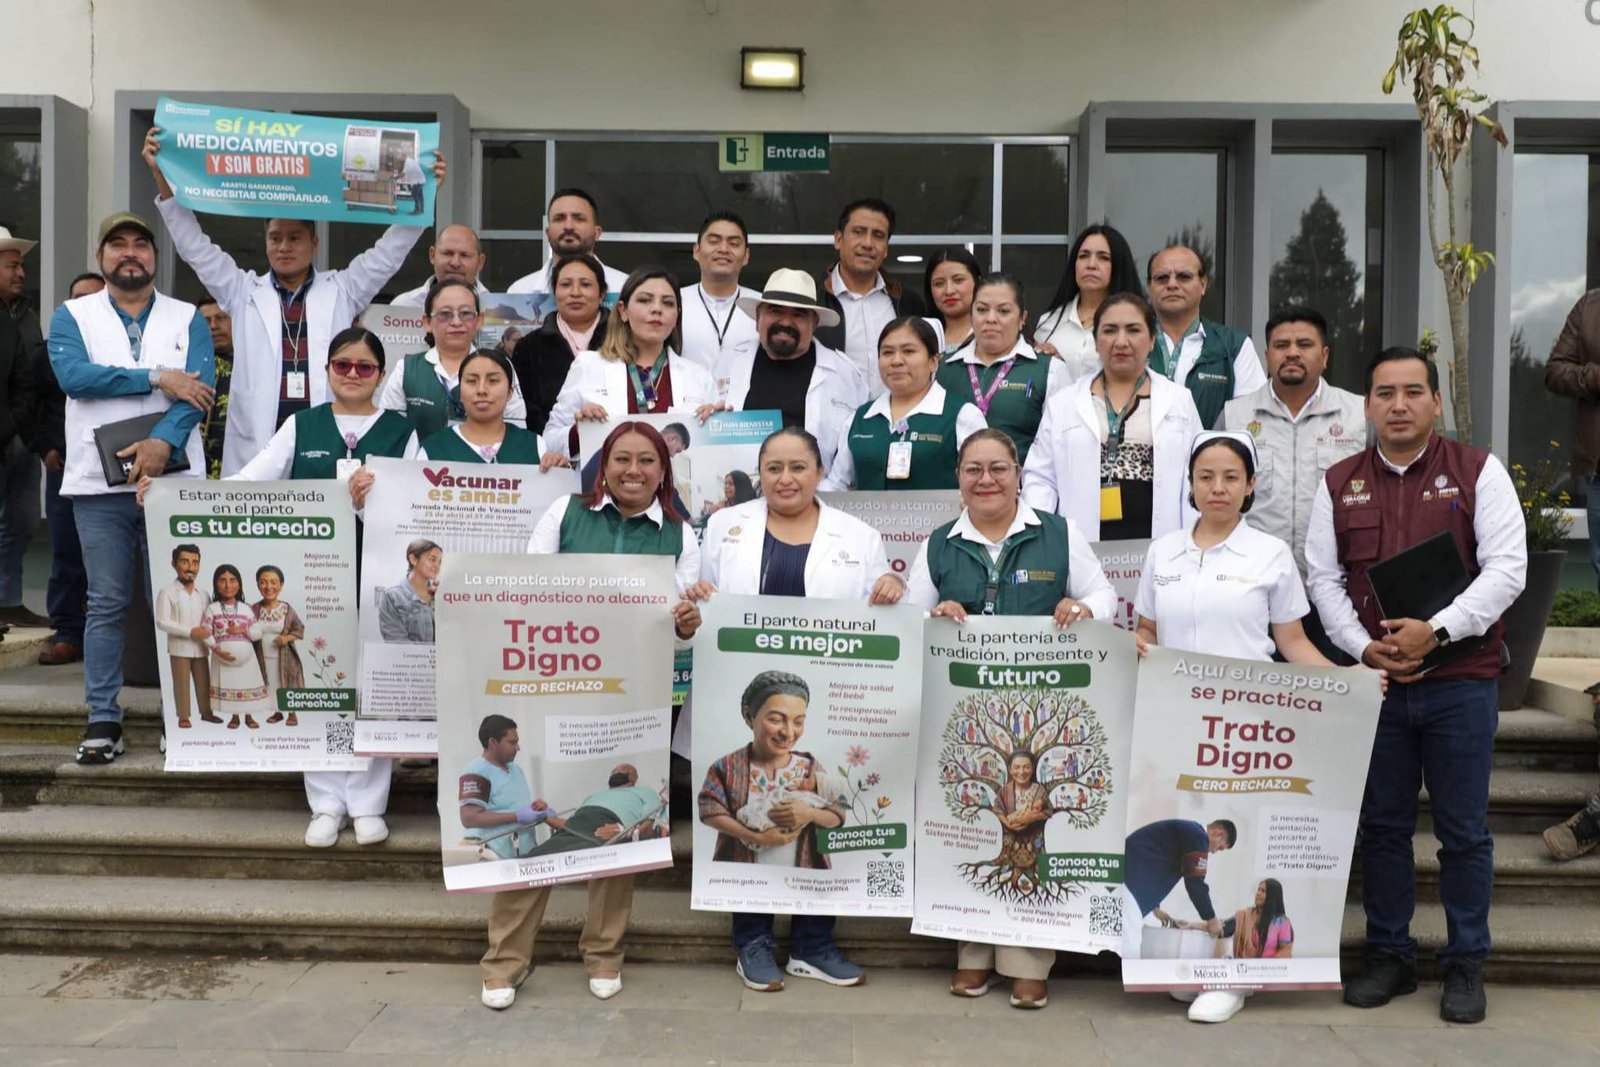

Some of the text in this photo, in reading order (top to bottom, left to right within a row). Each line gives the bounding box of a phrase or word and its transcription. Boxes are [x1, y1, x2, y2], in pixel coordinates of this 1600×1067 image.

[215, 116, 304, 137] SÍ HAY
[176, 133, 338, 158] MEDICAMENTOS
[767, 145, 825, 158] Entrada
[211, 155, 305, 175] Y SON GRATIS
[185, 186, 331, 204] NO NECESITAS COMPRARLOS.
[383, 315, 424, 329] Somo
[422, 467, 522, 490] Vacunar
[179, 489, 325, 504] Estar acompañada
[427, 489, 522, 505] es amar
[212, 503, 295, 517] en el parto
[411, 503, 441, 511] Jornada
[489, 506, 531, 514] Vacunación
[849, 500, 887, 511] todos
[891, 501, 951, 512] estamos
[176, 518, 332, 537] es tu derecho
[874, 515, 897, 528] por
[902, 514, 935, 529] algo,
[304, 552, 331, 561] Mejora
[1102, 552, 1145, 567] poder
[464, 573, 647, 589] La empatía abre puertas
[1123, 569, 1142, 579] un
[443, 591, 668, 605] que un diagnóstico no alcanza
[744, 612, 876, 632] El parto natural
[503, 619, 600, 645] Trato
[958, 630, 1077, 647] La partería es
[755, 633, 863, 657] es mejor
[502, 646, 602, 677] Digno
[930, 645, 1108, 665] tradición, presente y
[977, 666, 1061, 686] futuro
[1172, 658, 1350, 694] Aquí el respeto
[502, 681, 604, 694] CERO RECHAZO
[828, 682, 894, 692] Mejora la salud
[286, 690, 349, 700] Conoce tus
[1191, 686, 1322, 712] se practica
[287, 699, 340, 709] derechos
[828, 704, 897, 716] Tu recuperación
[859, 715, 888, 725] rápida
[610, 724, 645, 736] personal
[827, 728, 858, 737] Facilita
[1202, 715, 1296, 744] Trato
[1196, 743, 1294, 775] Digno
[1193, 778, 1291, 792] CERO RECHAZO
[1280, 815, 1320, 823] necesitas
[827, 827, 896, 841] Conoce tus
[923, 820, 949, 830] Ahora
[960, 825, 983, 836] parte
[985, 828, 998, 837] del
[827, 837, 885, 850] derechos
[925, 828, 998, 846] Sistema Nacional
[943, 840, 979, 851] de Salud
[1268, 843, 1303, 852] personal
[1048, 856, 1120, 868] Conoce tus
[1267, 853, 1289, 861] porta
[519, 866, 555, 877] México
[1049, 866, 1109, 879] derechos
[814, 885, 849, 893] MATERNA
[1036, 917, 1071, 928] MATERNA
[1193, 969, 1227, 979] México
